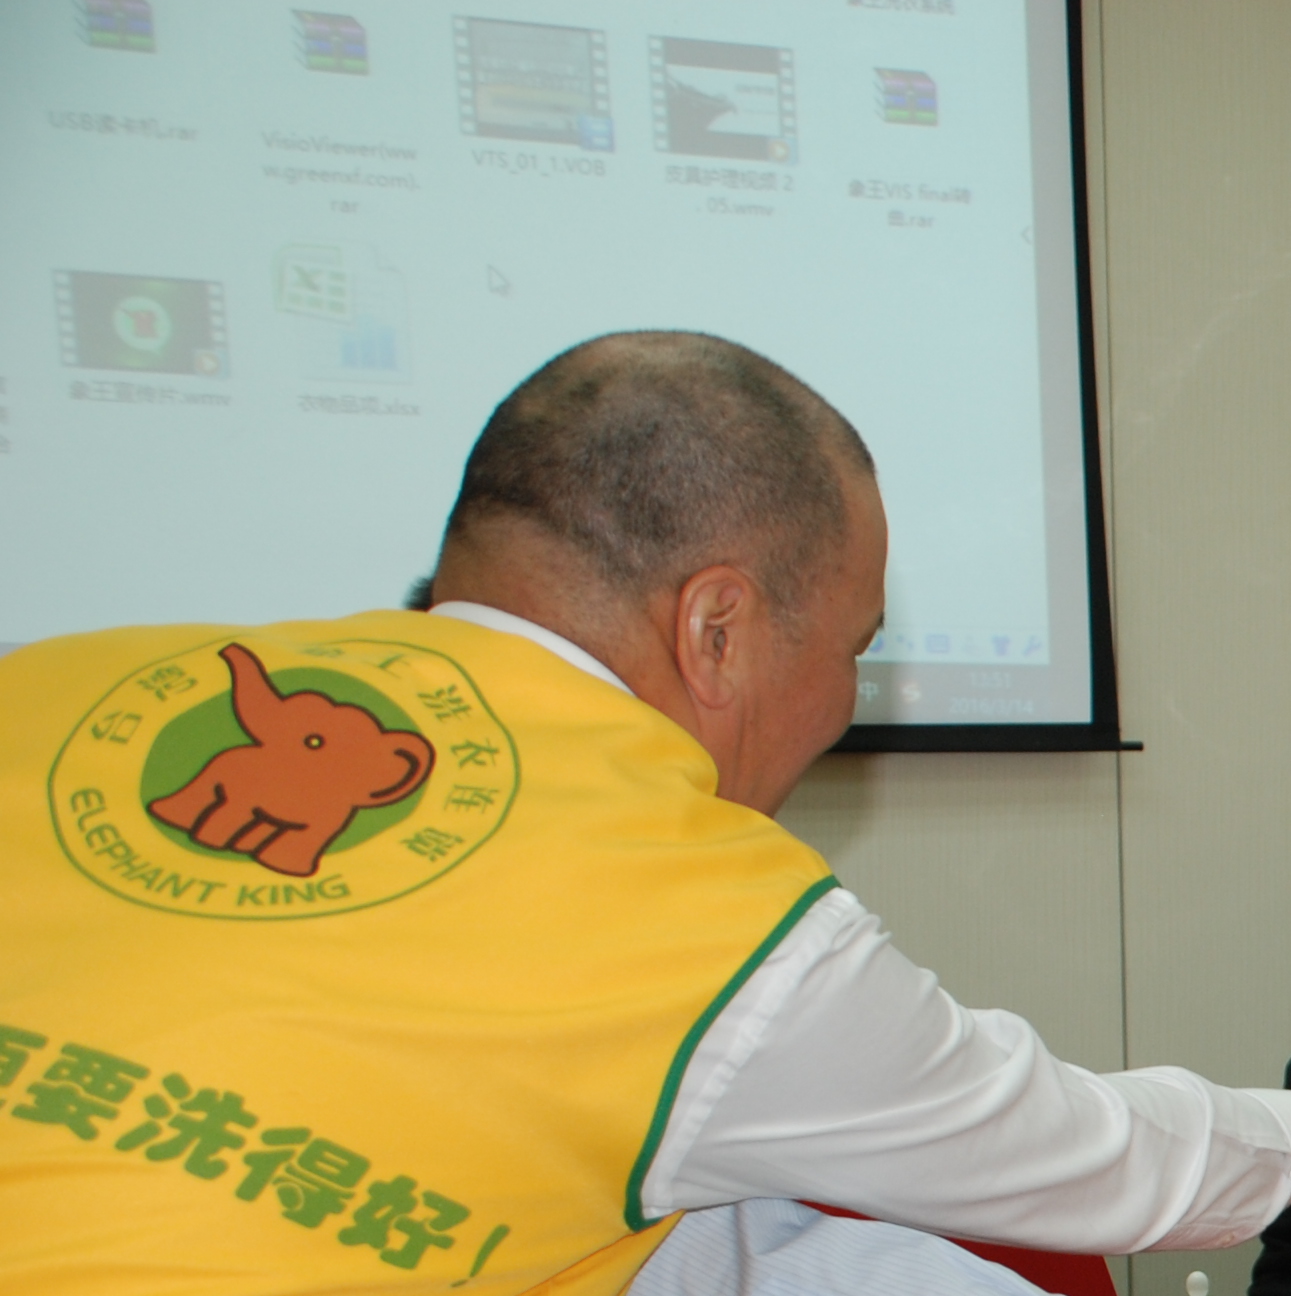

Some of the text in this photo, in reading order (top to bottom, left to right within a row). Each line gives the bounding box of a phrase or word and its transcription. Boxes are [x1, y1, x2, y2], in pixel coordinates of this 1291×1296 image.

[471, 148, 606, 178] VTS_01_1.VOB
[69, 785, 352, 908] ELEPHANT KING
